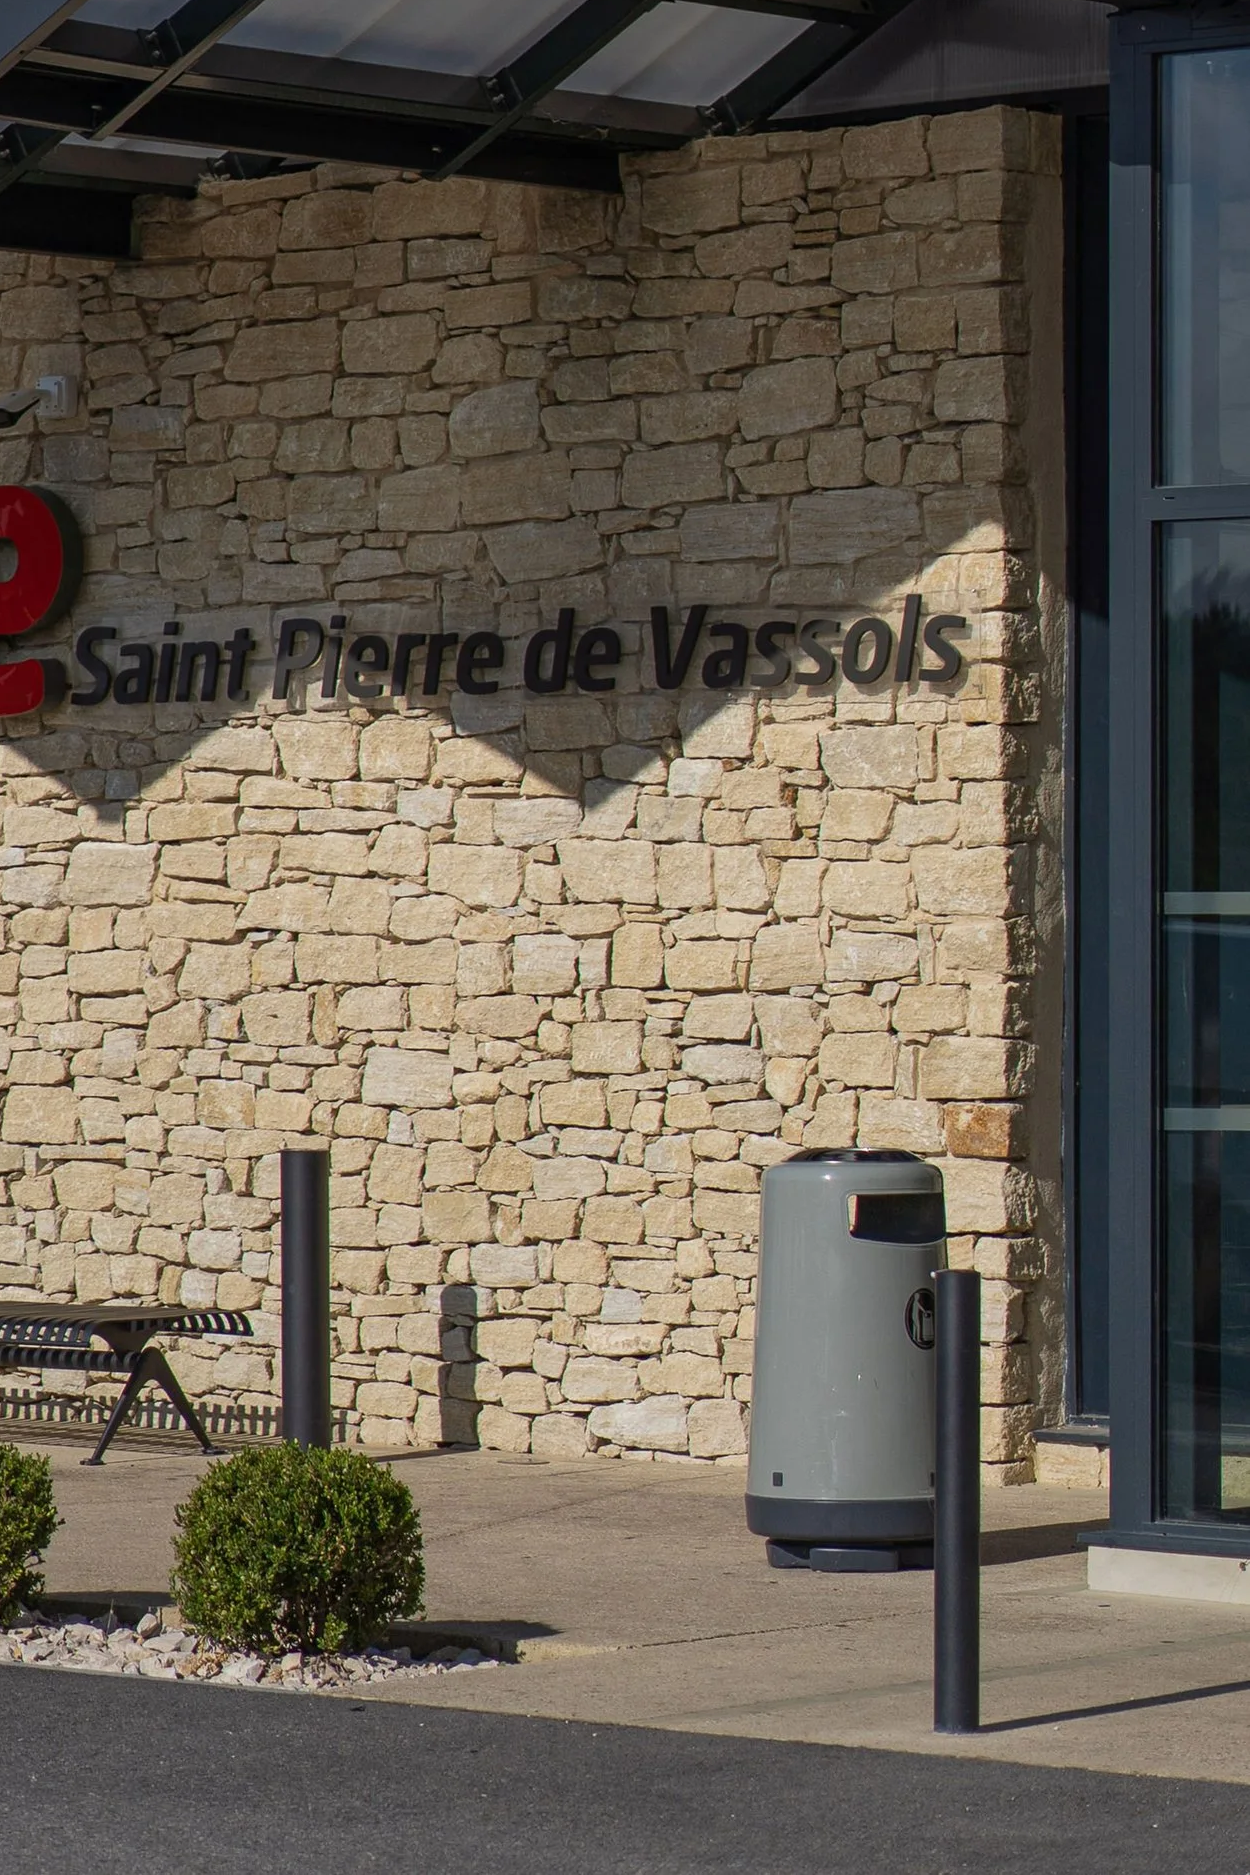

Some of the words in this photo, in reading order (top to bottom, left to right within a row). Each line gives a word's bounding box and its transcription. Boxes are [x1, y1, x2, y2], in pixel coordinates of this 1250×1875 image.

[70, 621, 255, 706] Saint
[271, 613, 505, 699] Pierre
[523, 607, 621, 694] de
[650, 592, 967, 691] Vassols
